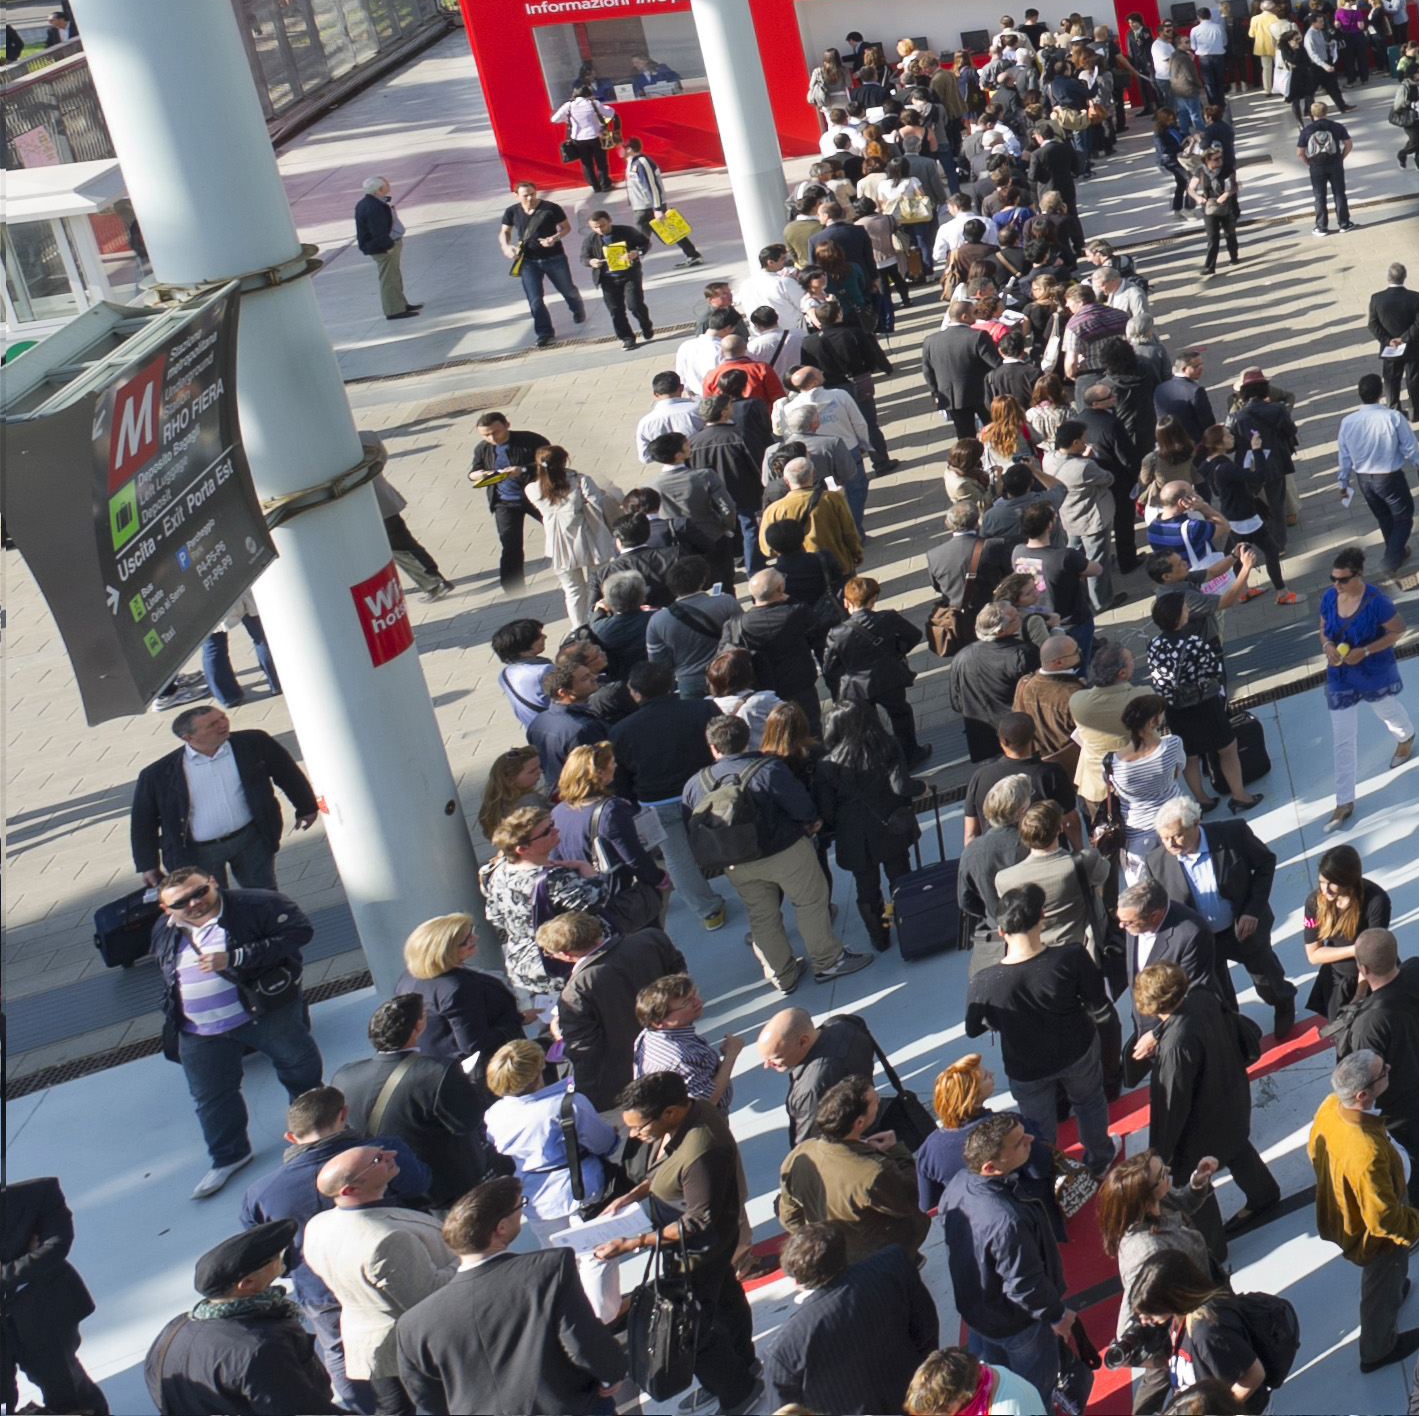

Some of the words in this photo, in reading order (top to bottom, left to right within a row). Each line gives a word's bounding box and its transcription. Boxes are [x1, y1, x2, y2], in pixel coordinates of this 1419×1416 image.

[167, 332, 217, 380] metropolitana
[170, 329, 202, 362] Stazione
[165, 350, 214, 400] Underground
[164, 390, 190, 418] Station
[164, 408, 189, 445] RHO
[192, 378, 224, 419] FIERA
[115, 381, 153, 470] M
[138, 451, 172, 487] Deposito
[173, 423, 200, 455] Bagagli
[140, 485, 155, 505] Left
[156, 456, 188, 490] Luggage
[117, 538, 156, 581] Uscita
[163, 505, 186, 536] Exit
[187, 480, 215, 514] Porta
[215, 458, 234, 485] Est
[142, 488, 172, 523] Deposit
[141, 583, 154, 598] Bus
[146, 589, 164, 610] Linate
[151, 608, 165, 622] Orio
[161, 626, 176, 643] Taxi
